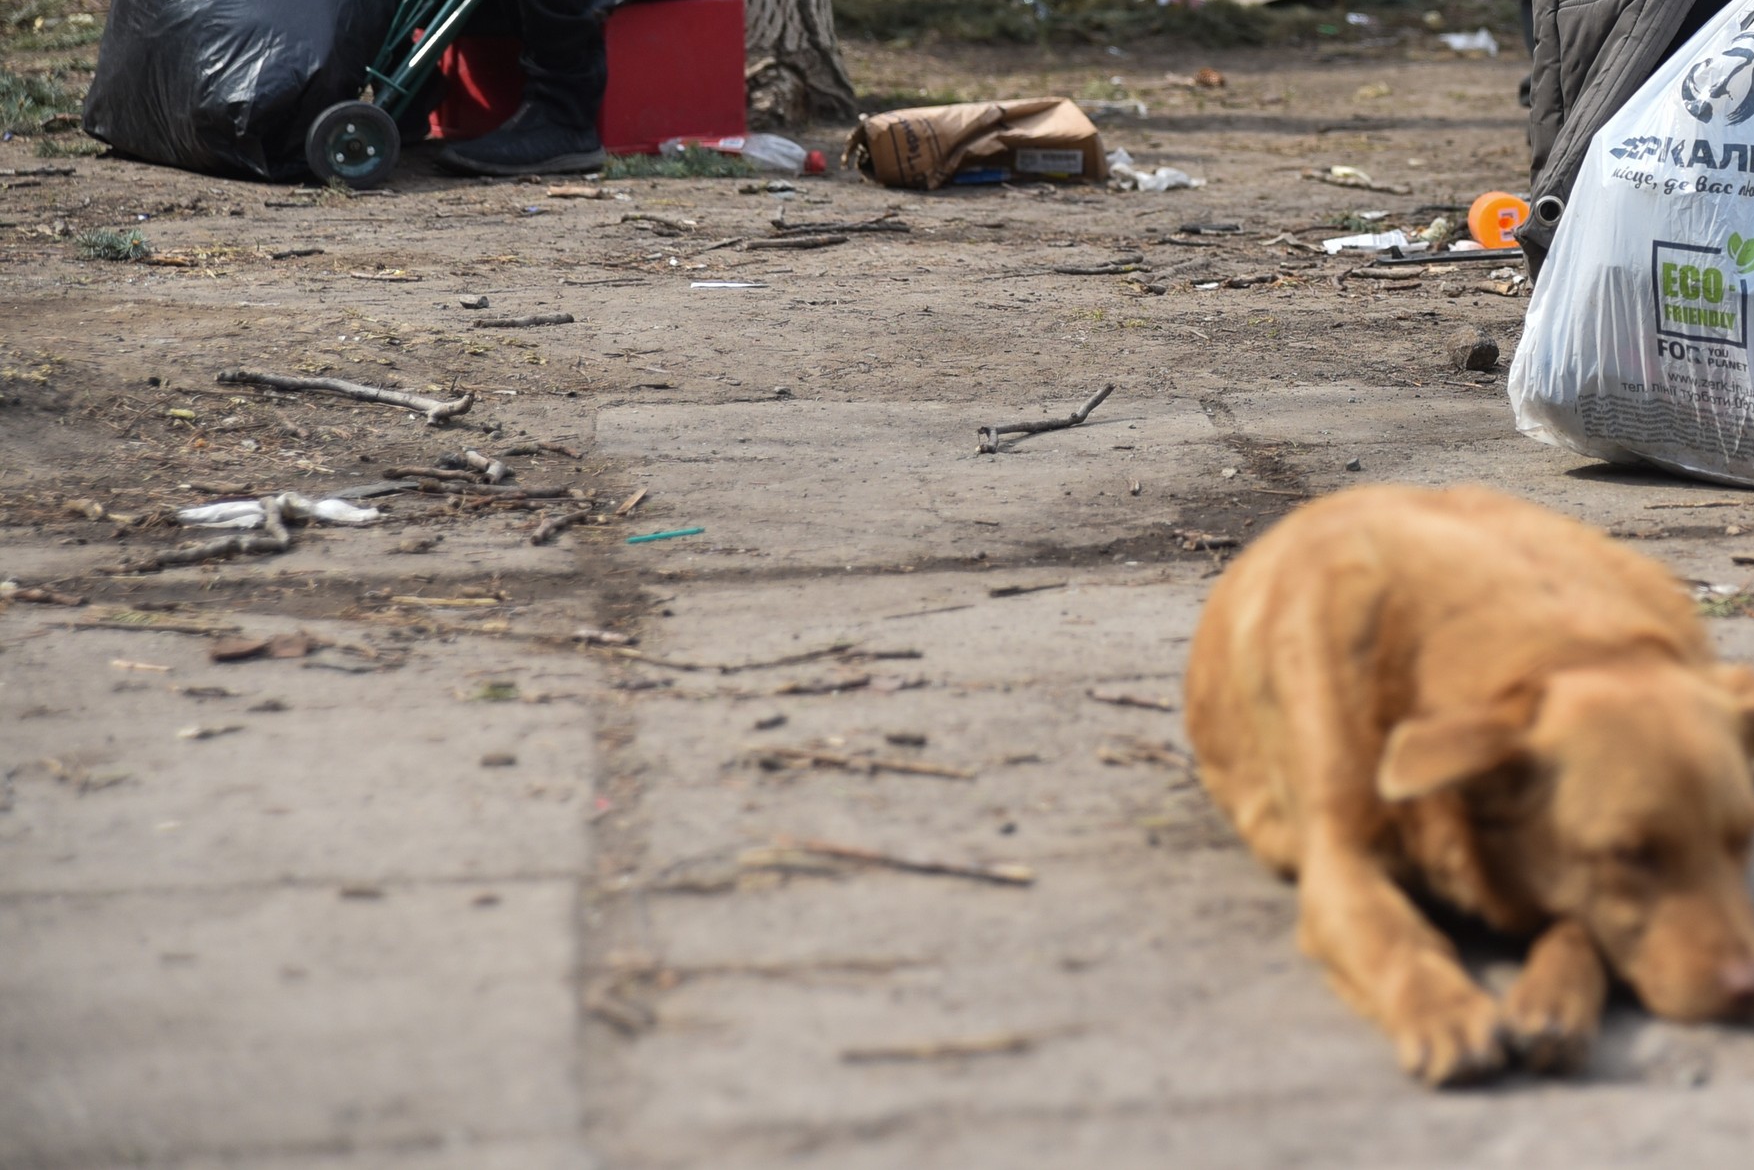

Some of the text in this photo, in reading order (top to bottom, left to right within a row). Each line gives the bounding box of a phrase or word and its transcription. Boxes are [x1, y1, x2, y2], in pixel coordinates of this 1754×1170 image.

[1664, 178, 1690, 195] де
[1664, 303, 1737, 331] FRIENDLY
[1706, 347, 1730, 360] YOU
[1707, 358, 1748, 373] PLANET
